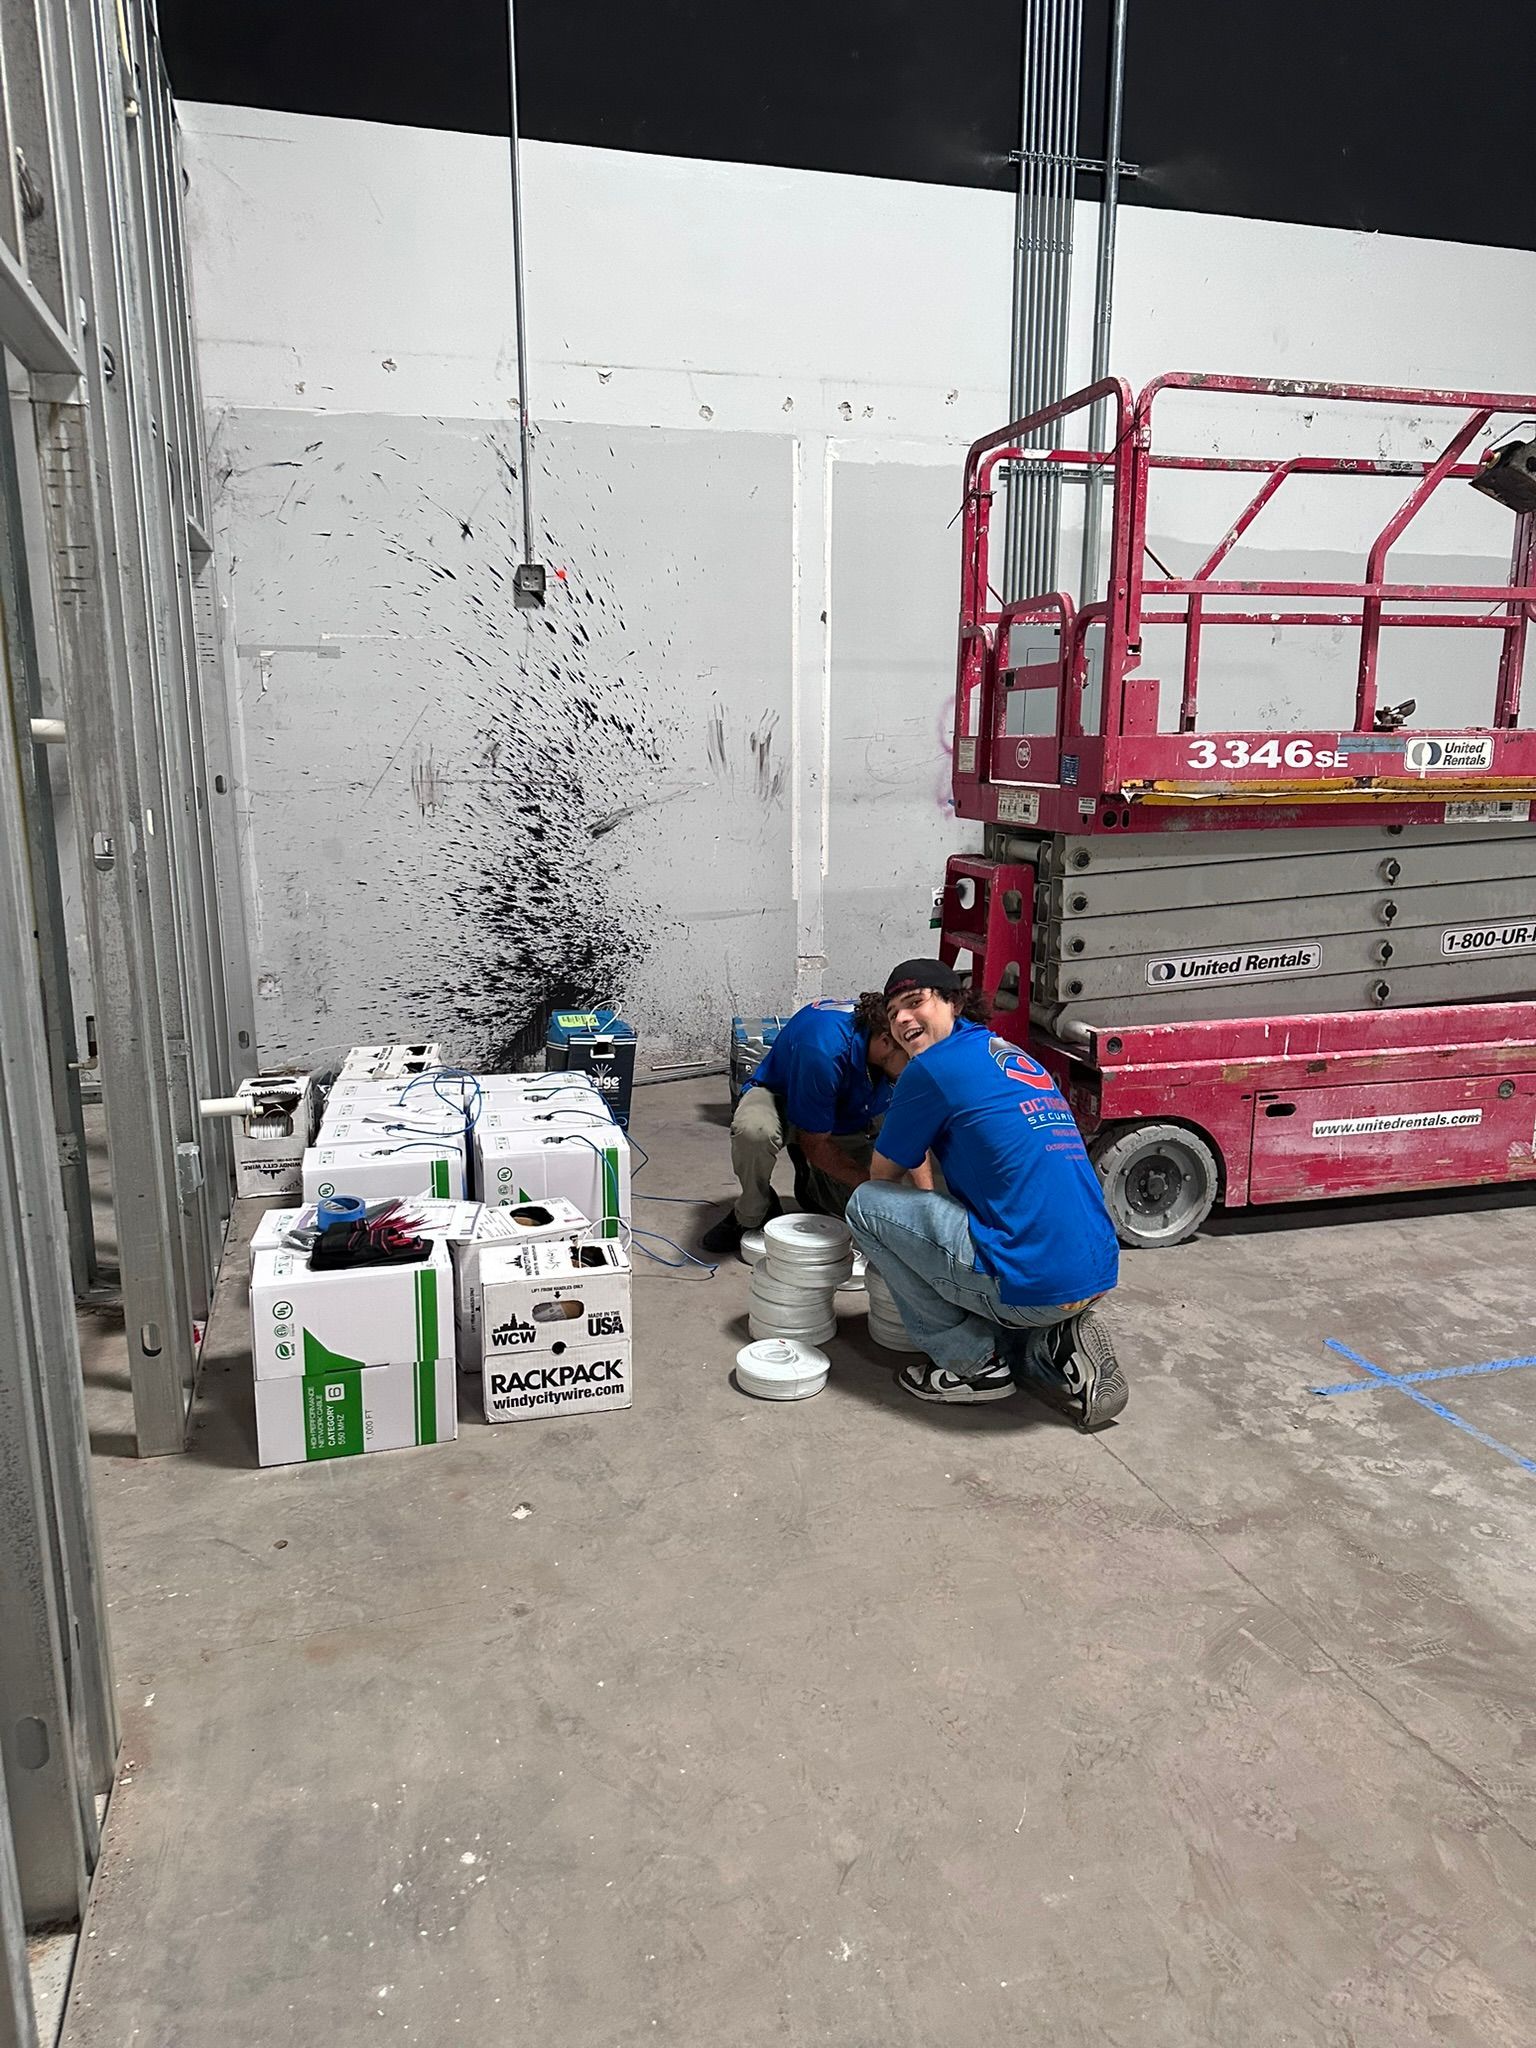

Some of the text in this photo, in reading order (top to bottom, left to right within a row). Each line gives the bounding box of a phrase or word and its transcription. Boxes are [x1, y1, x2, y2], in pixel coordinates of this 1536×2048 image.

[1442, 754, 1486, 766] Rentals
[1444, 742, 1485, 754] United
[1180, 950, 1312, 978] United Rentals
[1315, 1113, 1481, 1136] www.unitedrentals.com
[491, 1330, 536, 1347] WCW
[588, 1316, 625, 1336] USA
[491, 1358, 624, 1395] RACKPACK
[307, 1386, 317, 1433] PERFORMANCE
[493, 1383, 625, 1410] windycitywire.com
[315, 1395, 325, 1448] NETWORK CABLE
[326, 1386, 342, 1447] CATEGORY 6
[364, 1409, 373, 1419] FT
[336, 1414, 346, 1445] 550 MHZ
